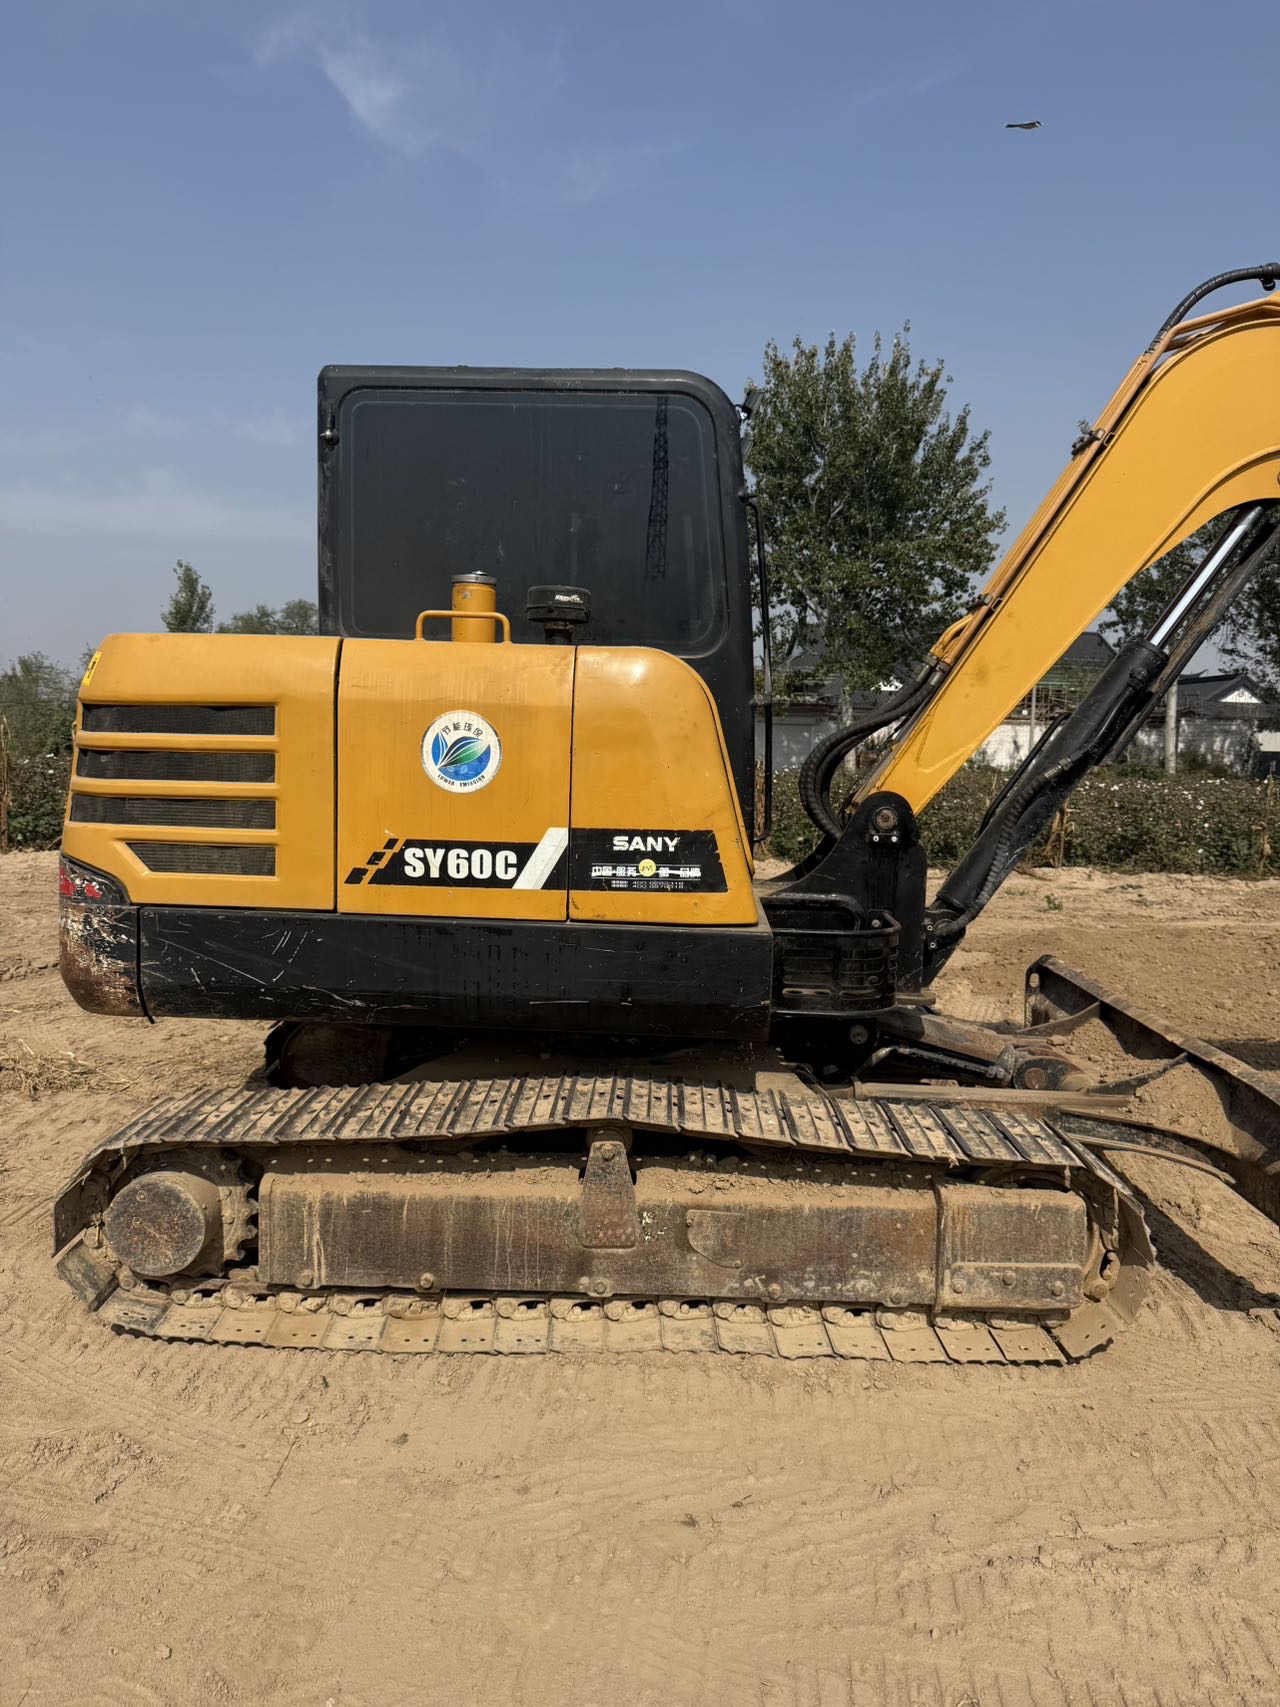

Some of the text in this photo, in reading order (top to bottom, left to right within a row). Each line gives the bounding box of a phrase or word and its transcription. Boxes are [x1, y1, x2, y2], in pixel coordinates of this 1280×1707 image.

[437, 774, 485, 787] LOWER EMISSION
[613, 836, 681, 851] SANY
[404, 848, 517, 880] SY60C
